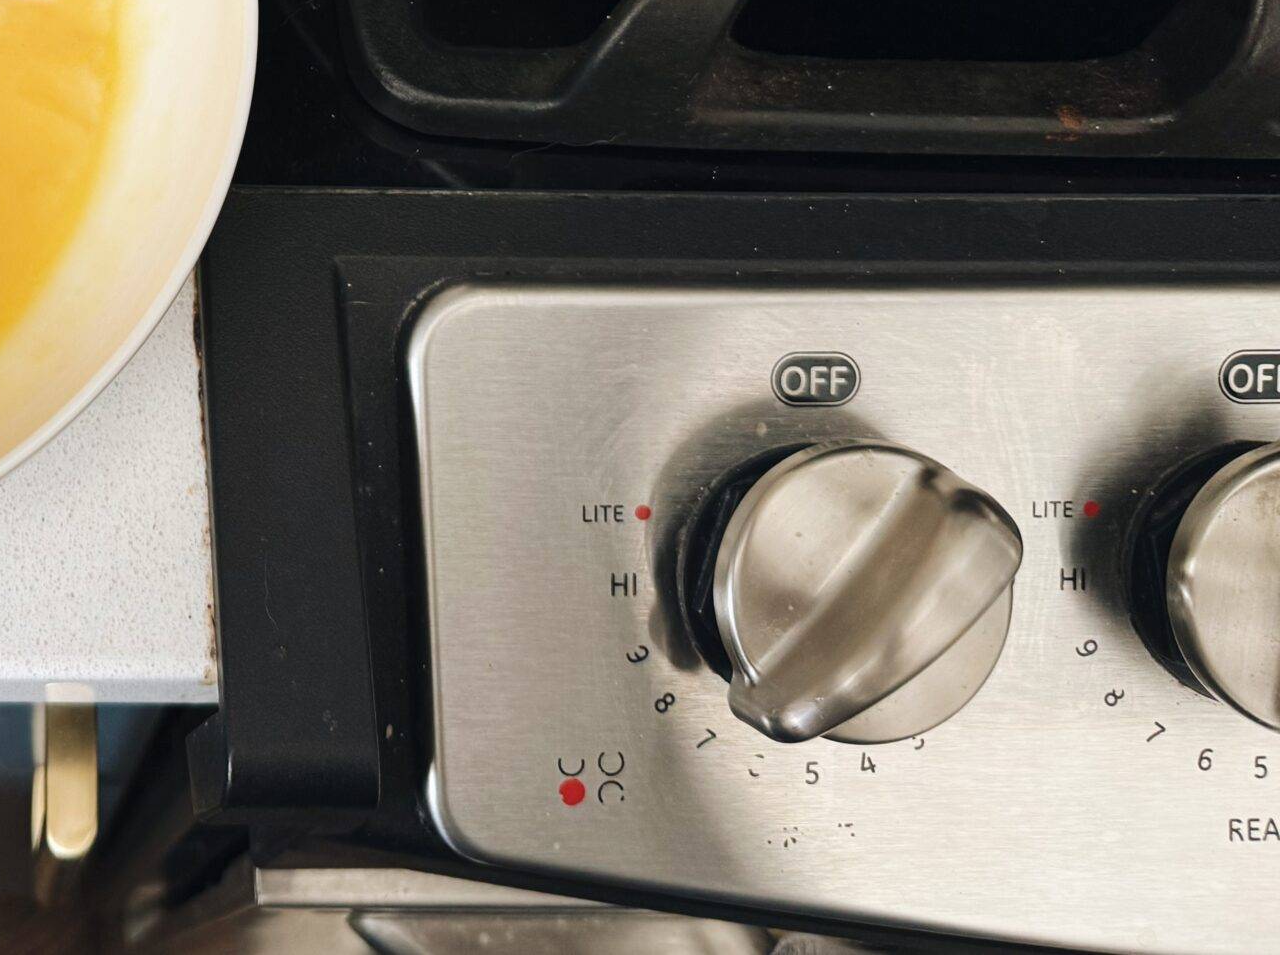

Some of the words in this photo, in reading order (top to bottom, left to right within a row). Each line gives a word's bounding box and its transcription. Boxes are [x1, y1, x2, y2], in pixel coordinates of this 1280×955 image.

[780, 365, 849, 397] OFF
[1228, 363, 1280, 394] OF
[582, 505, 624, 522] LITE
[1032, 501, 1073, 518] LITE
[610, 572, 637, 596] HI
[1060, 568, 1086, 591] HI
[1076, 639, 1098, 657] 9
[654, 692, 676, 713] 8
[696, 728, 717, 749] 7
[1146, 721, 1166, 742] 7
[860, 751, 876, 773] 4
[1197, 748, 1214, 771] 6
[1254, 755, 1268, 779] 5
[805, 761, 820, 785] 5
